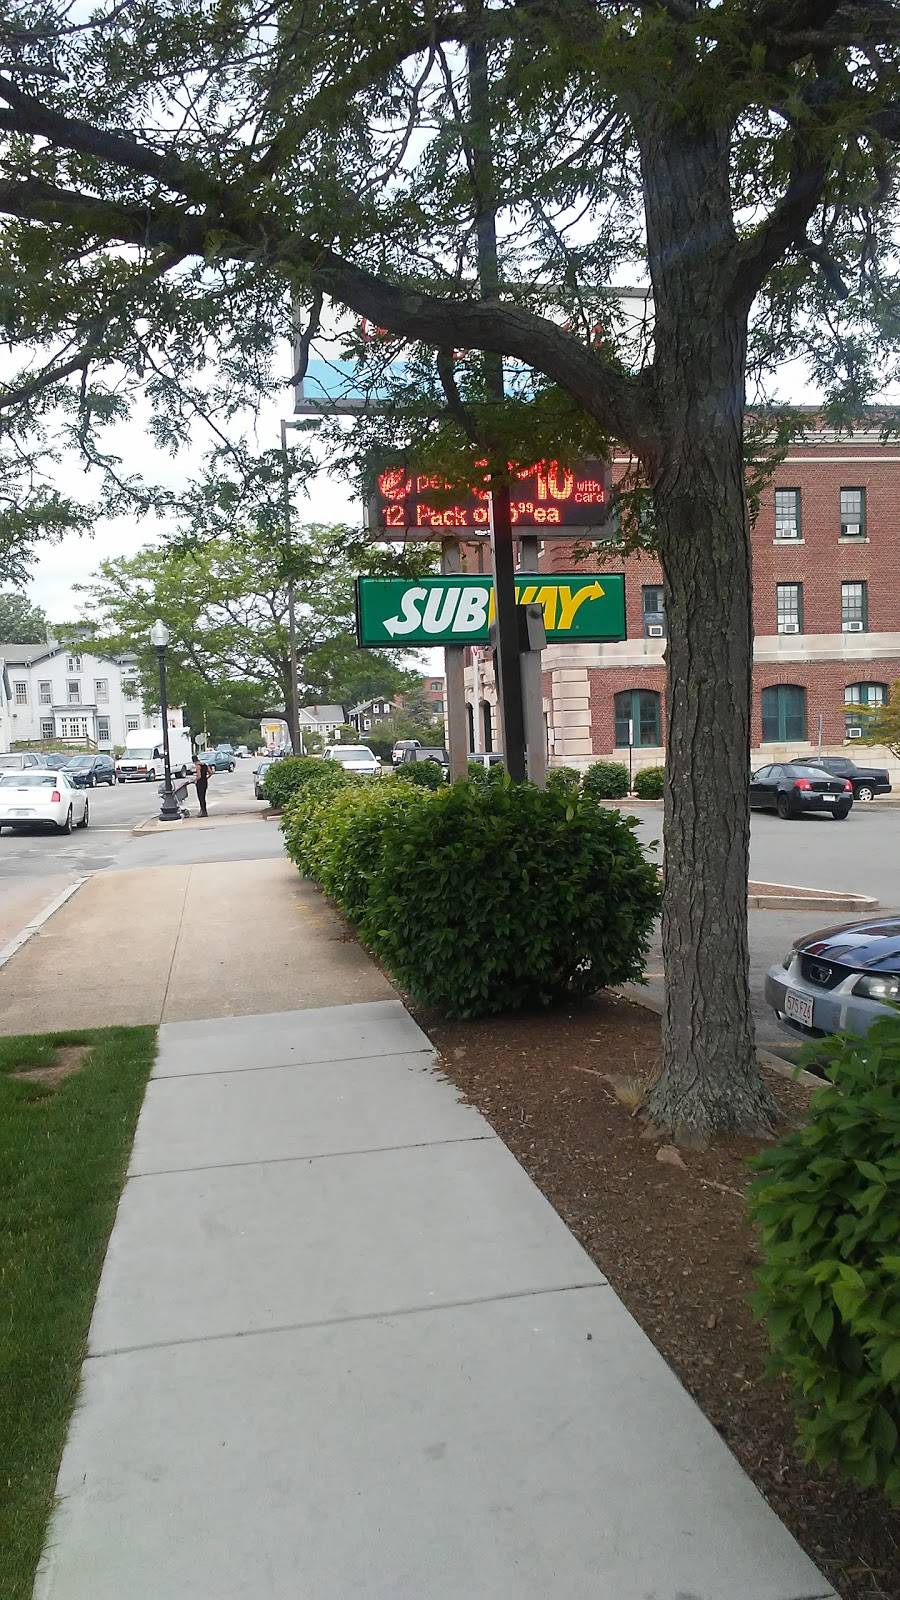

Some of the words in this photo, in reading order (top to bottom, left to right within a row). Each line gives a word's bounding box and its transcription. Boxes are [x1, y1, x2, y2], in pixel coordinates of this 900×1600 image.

[576, 480, 601, 492] with
[574, 491, 605, 503] card
[382, 504, 404, 526] 12
[416, 504, 467, 526] Pack
